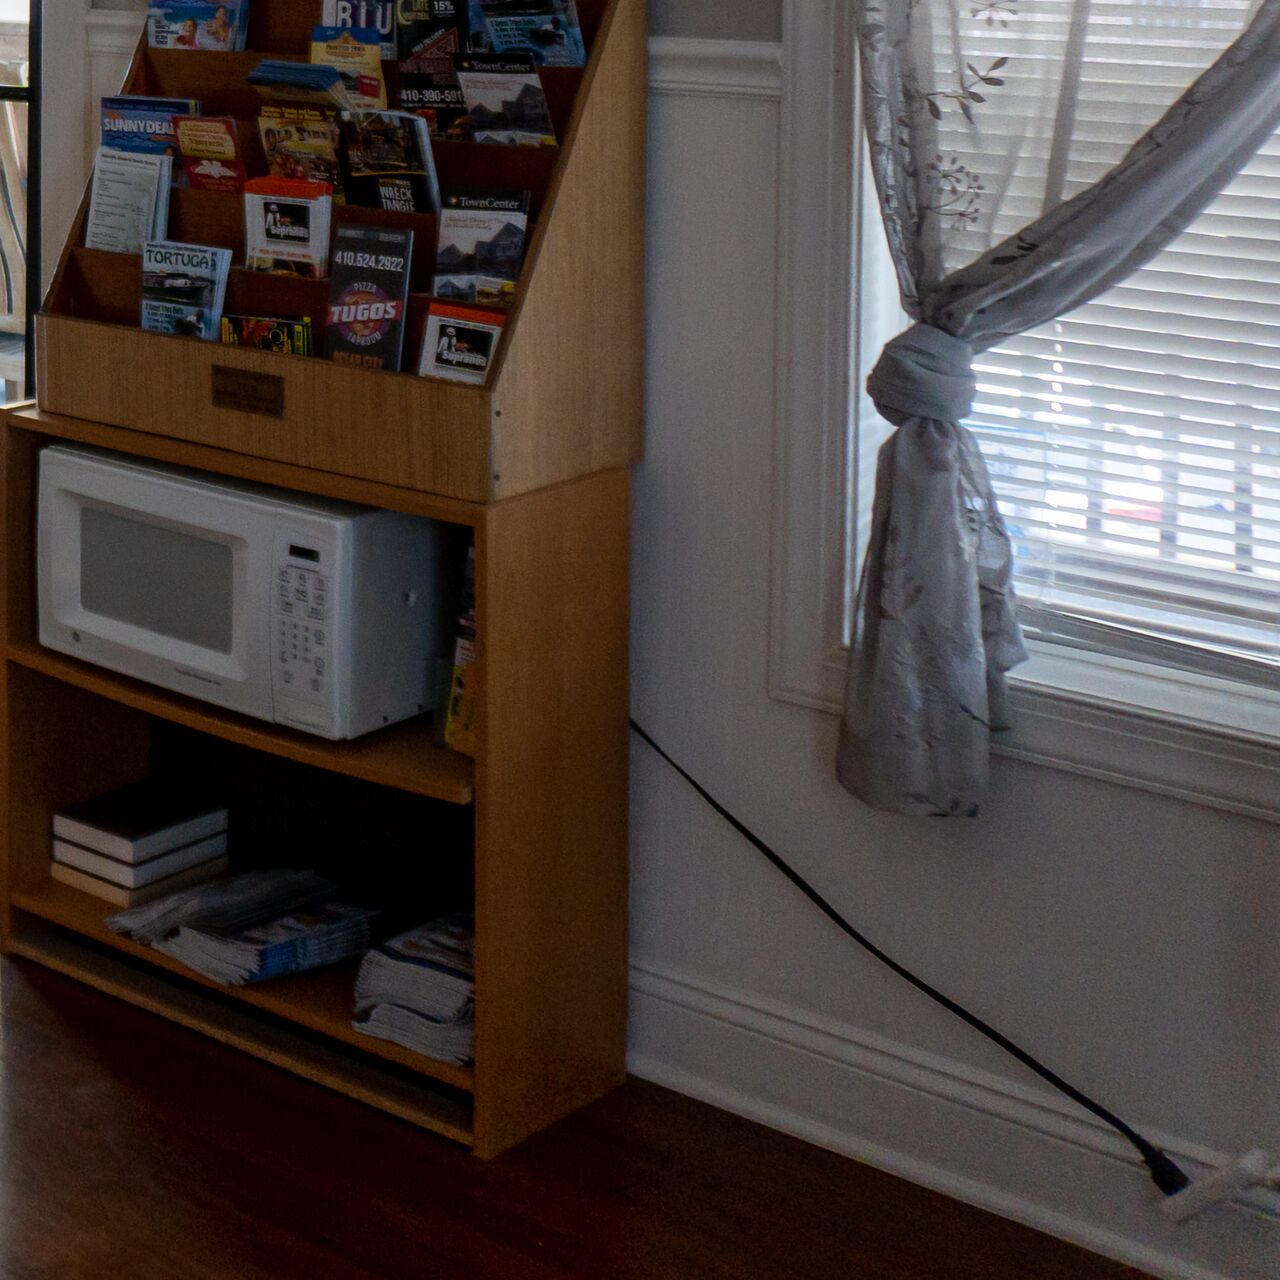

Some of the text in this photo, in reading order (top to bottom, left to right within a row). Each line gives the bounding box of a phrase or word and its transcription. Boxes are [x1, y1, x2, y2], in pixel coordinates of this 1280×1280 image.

[433, 0, 455, 11] 15%
[472, 60, 531, 72] TownCenter
[400, 88, 461, 102] 410-390-591
[103, 119, 145, 133] SUNNY
[379, 186, 414, 202] WRECK
[460, 195, 520, 209] TownCenter
[145, 249, 209, 269] TORTUGA
[335, 250, 404, 272] 410.524.2922
[352, 281, 377, 293] PIZZA
[330, 301, 398, 323] TUGOS
[346, 331, 383, 347] TAPROOM
